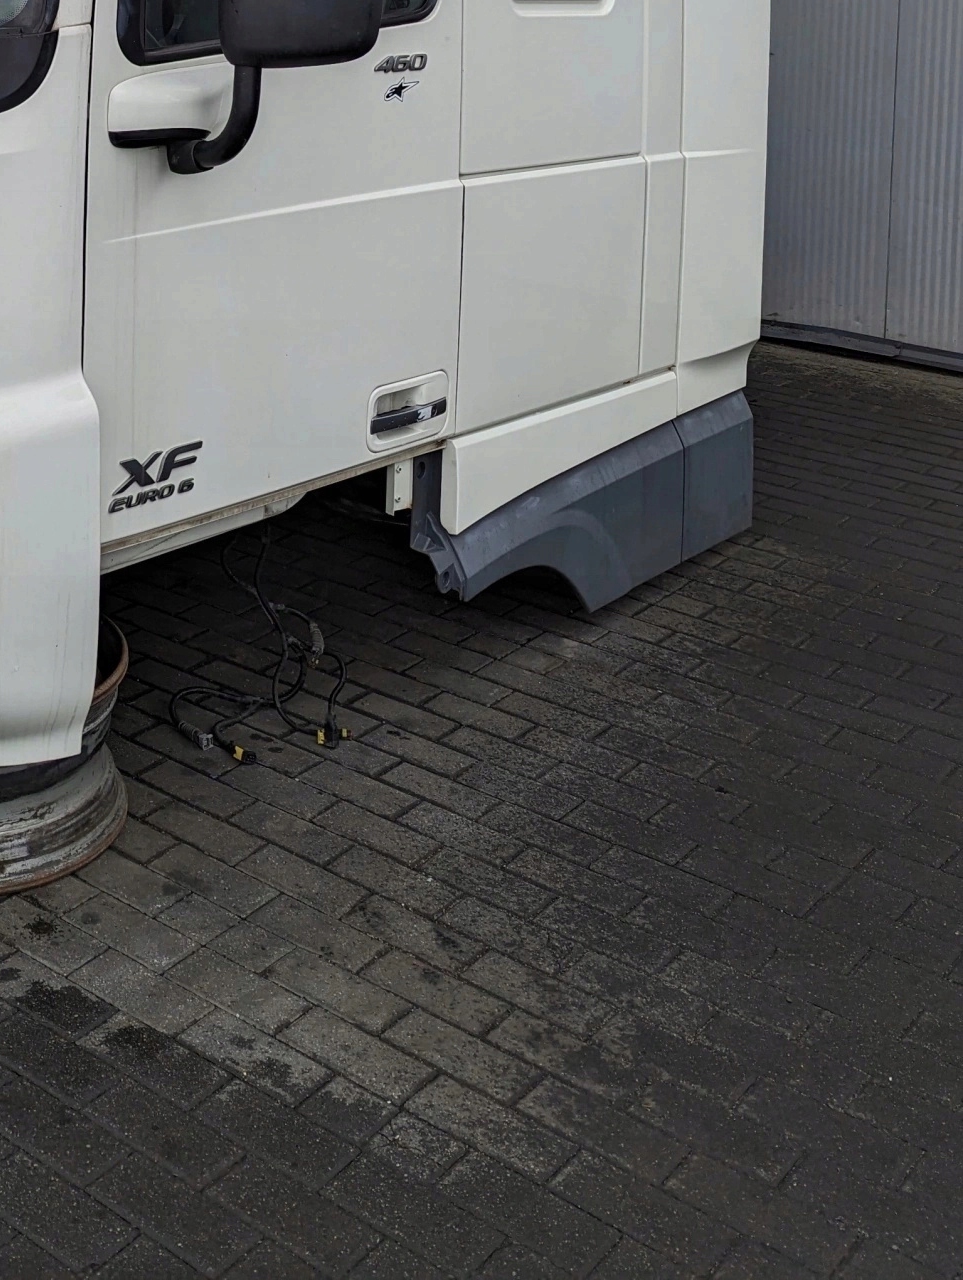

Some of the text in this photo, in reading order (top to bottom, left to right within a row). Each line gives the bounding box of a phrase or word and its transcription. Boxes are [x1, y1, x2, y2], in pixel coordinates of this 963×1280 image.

[373, 53, 427, 73] 460
[112, 440, 203, 496] XF
[108, 477, 195, 514] EURO 6
